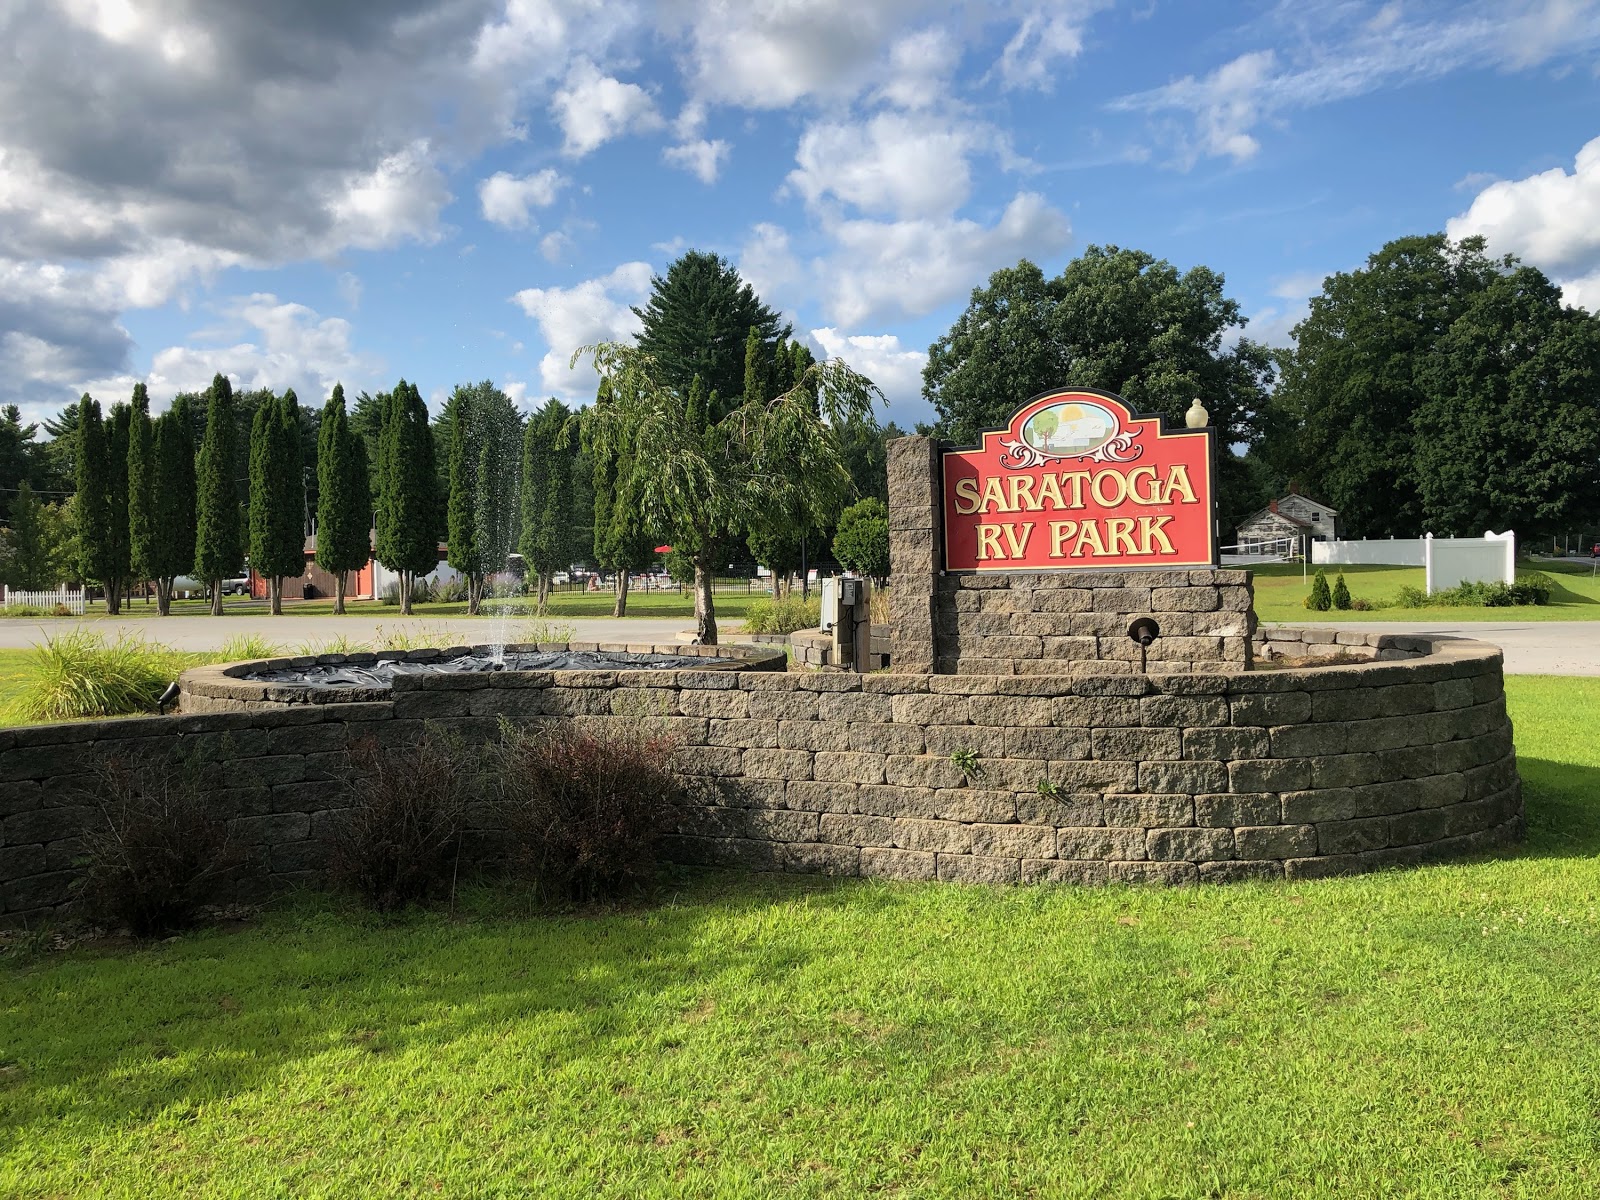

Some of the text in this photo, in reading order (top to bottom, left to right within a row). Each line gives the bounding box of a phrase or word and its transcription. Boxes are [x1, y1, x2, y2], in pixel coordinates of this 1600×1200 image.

[955, 464, 1199, 515] SARATOGA
[975, 515, 1177, 560] RV PARK
